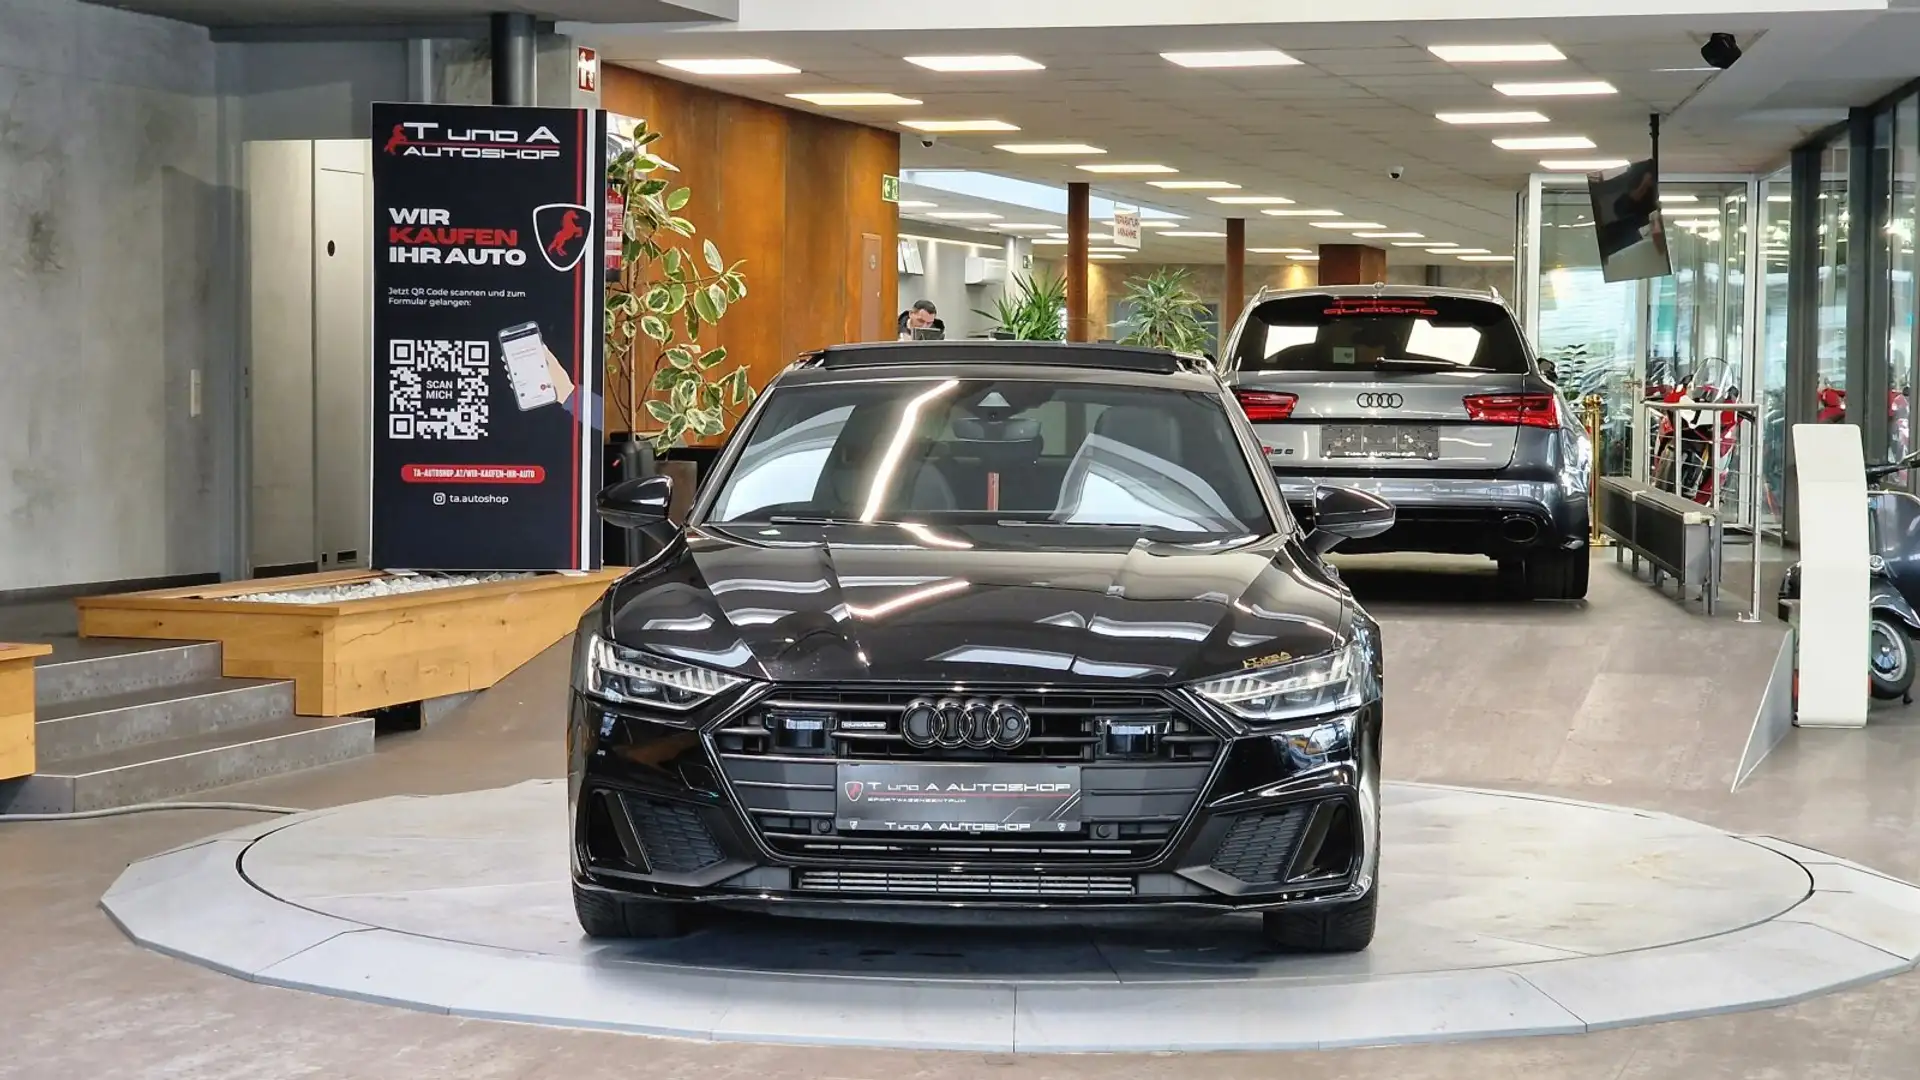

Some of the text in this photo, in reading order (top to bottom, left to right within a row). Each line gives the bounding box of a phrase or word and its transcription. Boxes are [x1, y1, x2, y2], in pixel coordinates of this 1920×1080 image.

[403, 122, 439, 139] T
[526, 126, 560, 144] A
[403, 146, 560, 160] AUTOSHOP
[388, 208, 450, 225] WIR
[388, 227, 518, 246] KAUFEN
[388, 247, 527, 266] IHR AUTO
[388, 287, 410, 296] Jetzt
[411, 288, 425, 296] QR
[426, 288, 448, 296] Code
[428, 298, 472, 308] gelangen:
[1324, 307, 1438, 315] quattro
[426, 380, 453, 389] SCAN
[426, 390, 453, 400] MICH
[449, 494, 508, 504] ta.autoshop
[867, 782, 882, 790] T
[924, 783, 940, 791] A
[946, 783, 1070, 792] AUTOSHOP
[884, 822, 896, 830] T
[921, 822, 932, 830] A
[938, 822, 1030, 832] AUTOSHOP
